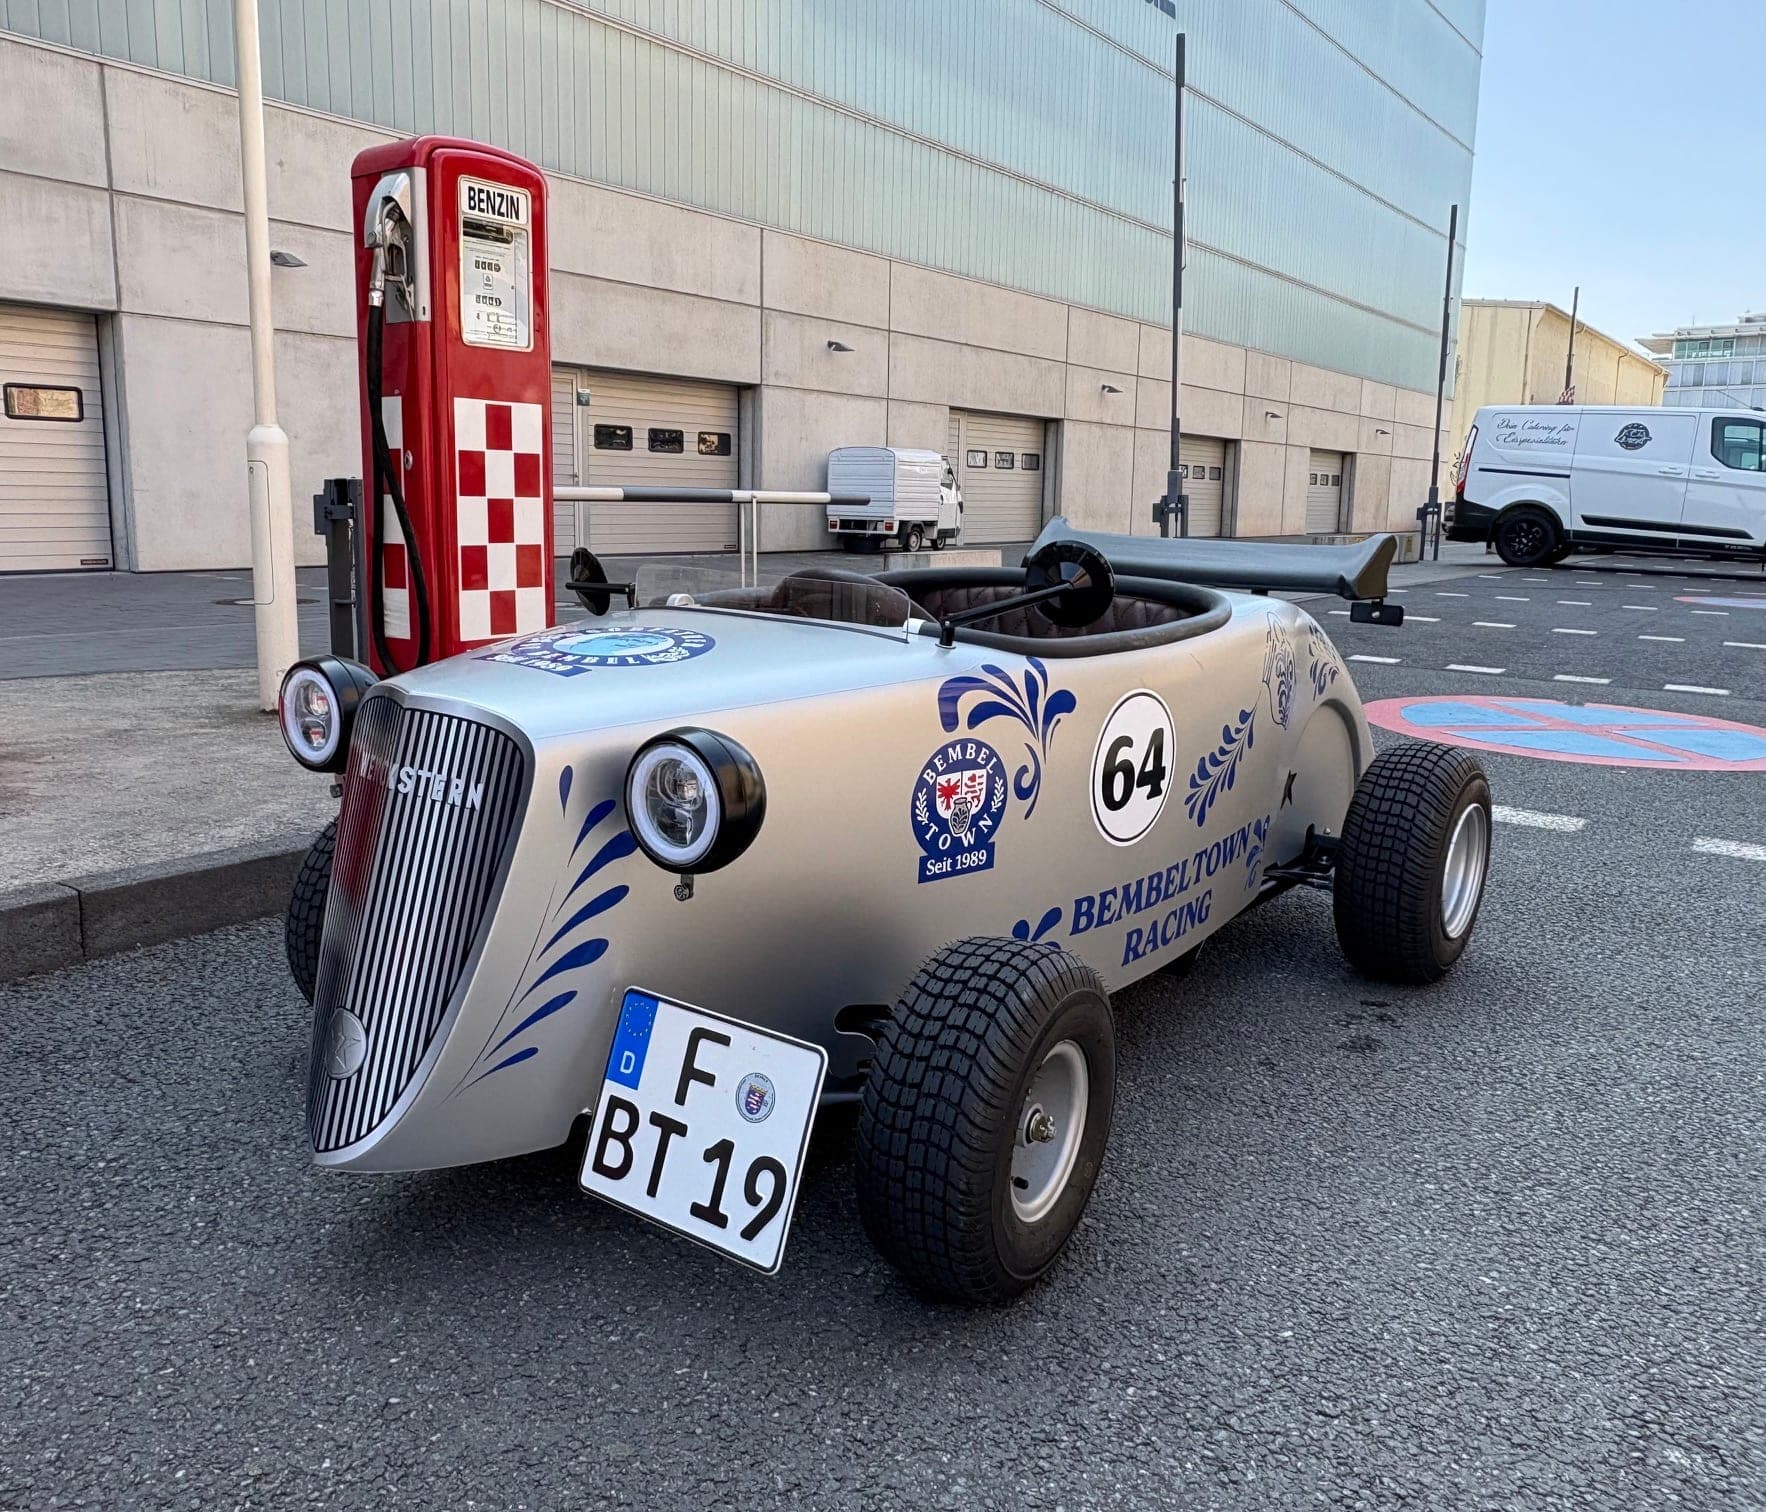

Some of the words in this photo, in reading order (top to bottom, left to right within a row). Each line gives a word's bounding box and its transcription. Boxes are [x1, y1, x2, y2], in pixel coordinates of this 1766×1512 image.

[468, 186, 520, 221] BENZIN
[1521, 420, 1558, 435] Catering
[923, 743, 998, 786] BEMBEL
[1101, 727, 1167, 812] 64
[924, 813, 993, 850] TOWN
[926, 857, 953, 876] Seit
[955, 849, 987, 870] 1989
[1121, 888, 1213, 967] RACING
[620, 1051, 636, 1074] D
[674, 1026, 732, 1107] F
[592, 1094, 688, 1199] BT
[689, 1138, 788, 1242] 19
